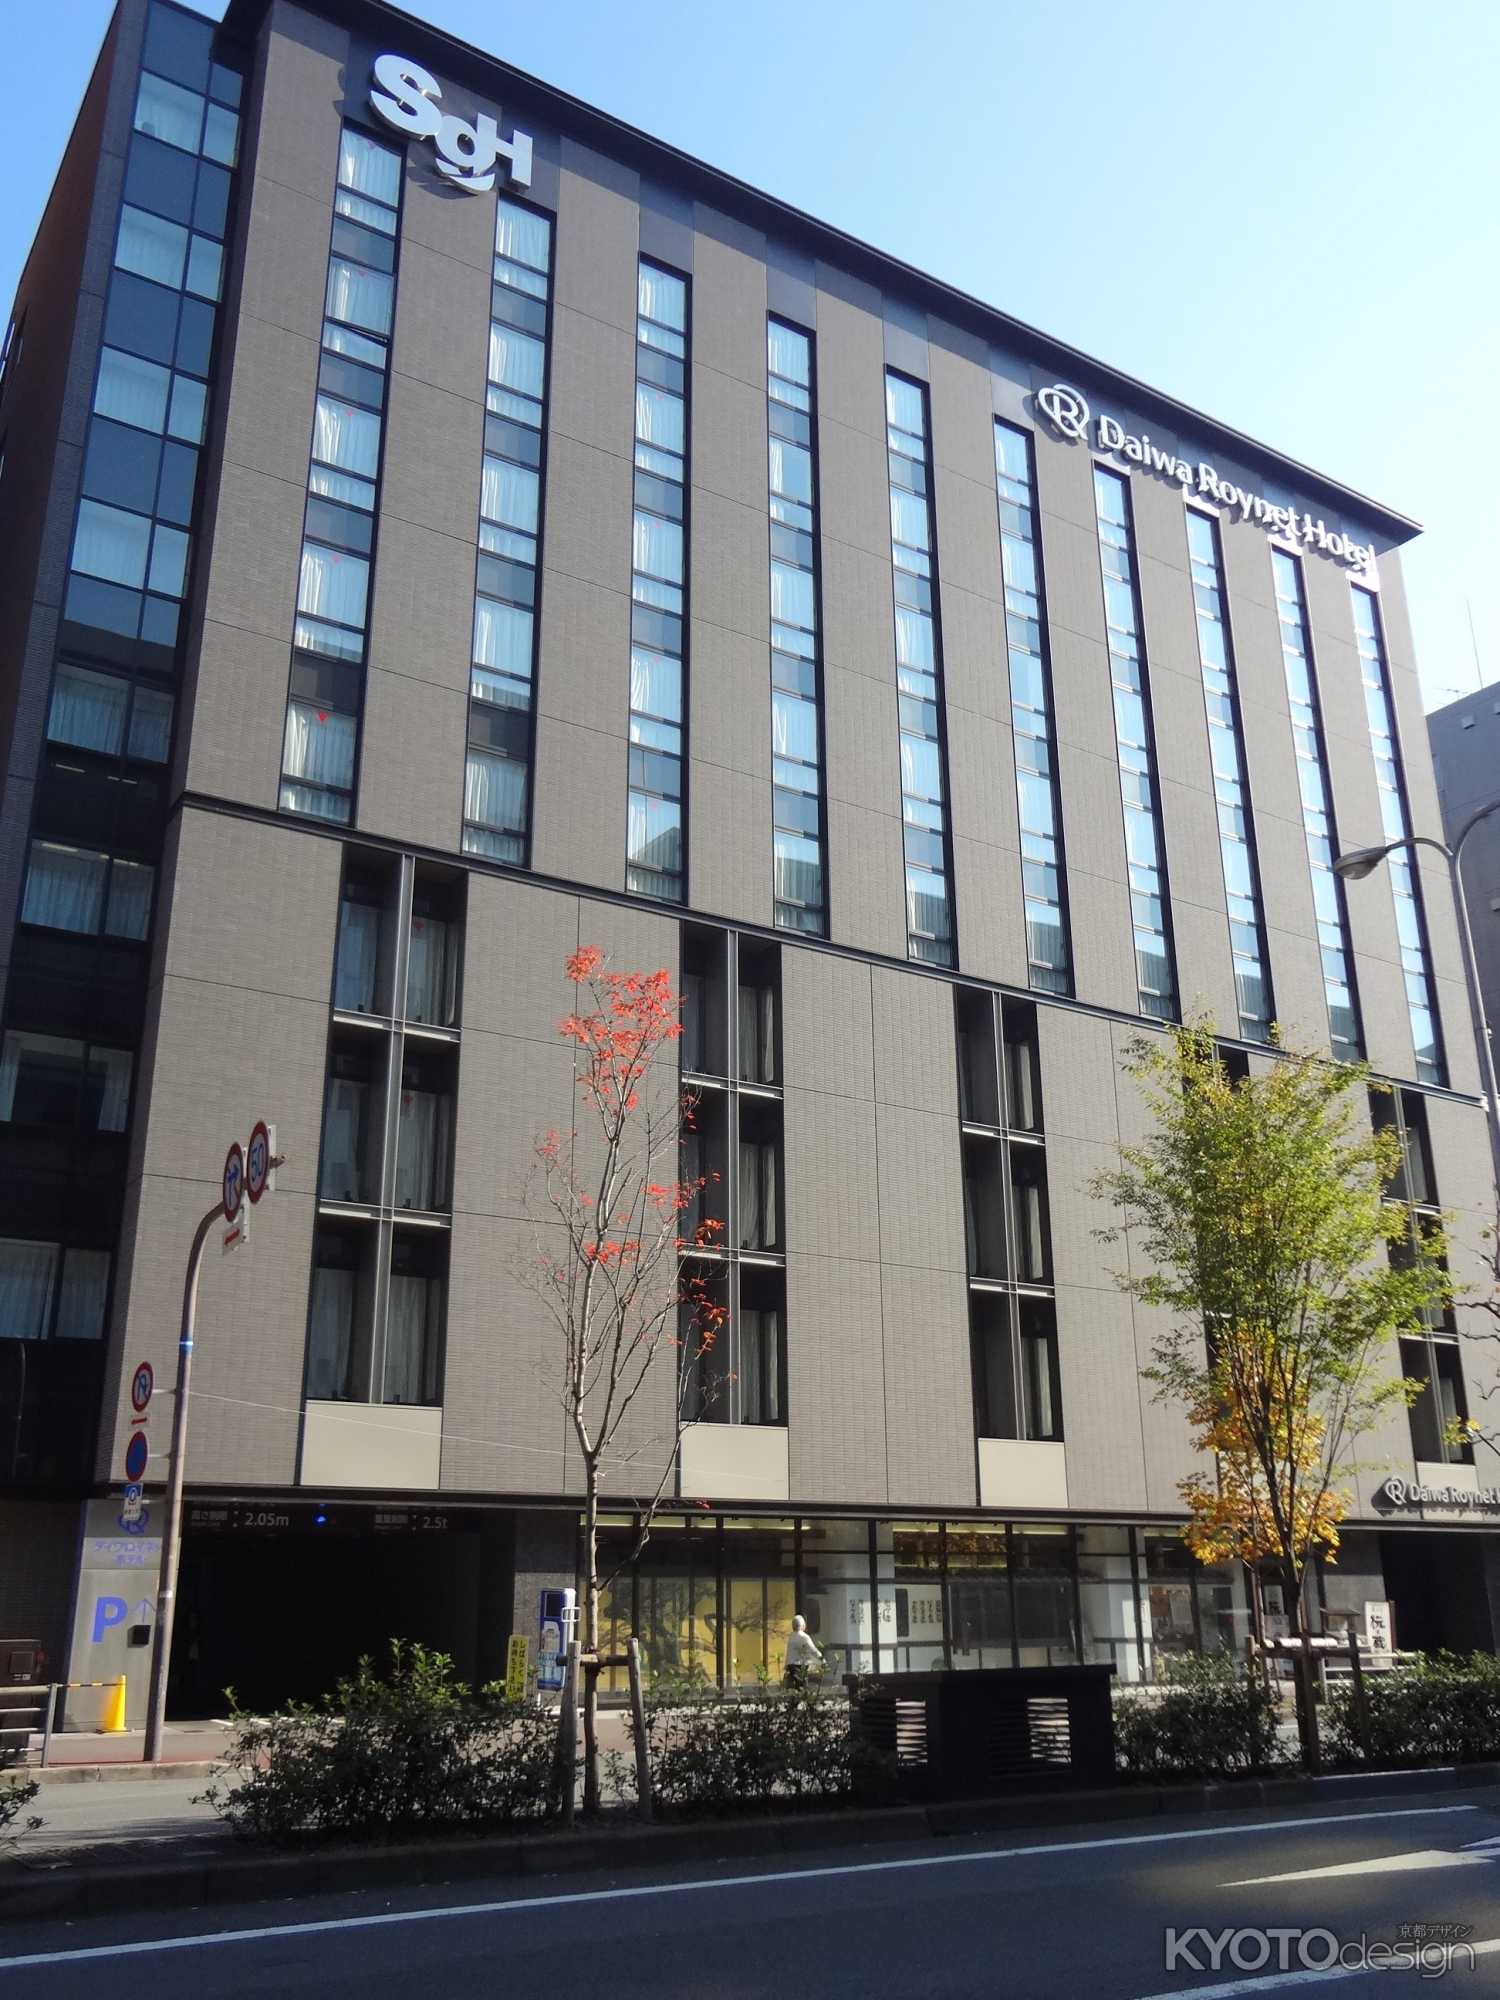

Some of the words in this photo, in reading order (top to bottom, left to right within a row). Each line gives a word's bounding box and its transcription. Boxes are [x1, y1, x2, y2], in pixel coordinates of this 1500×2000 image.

[1098, 414, 1193, 486] Daiwa
[1197, 462, 1302, 537] Roynet
[1302, 513, 1378, 573] Hotel
[251, 1143, 264, 1183] 50
[1410, 1483, 1450, 1503] Daiwa
[1451, 1487, 1497, 1509] Roynet
[244, 1512, 289, 1527] 2.05m
[91, 1596, 127, 1643] P
